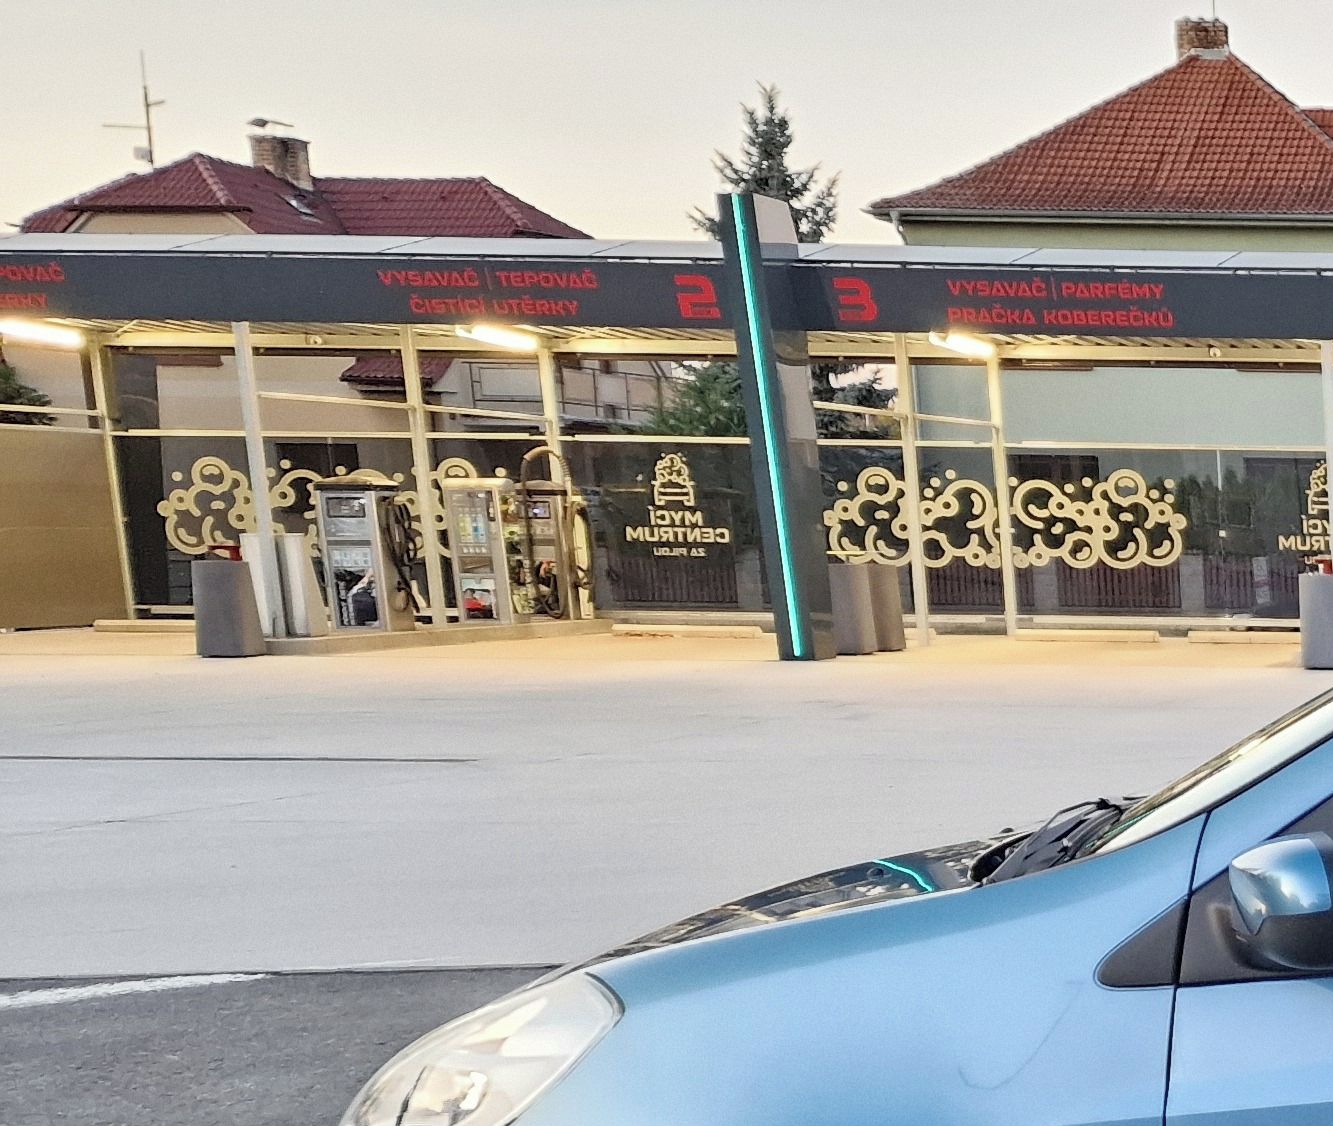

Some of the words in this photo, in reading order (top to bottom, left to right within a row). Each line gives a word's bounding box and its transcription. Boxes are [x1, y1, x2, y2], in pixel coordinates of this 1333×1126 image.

[377, 267, 480, 288] VYSAVAČ
[496, 268, 598, 289] TEPOVAČ
[947, 277, 1048, 298] VYSAVAČ
[1061, 280, 1164, 299] PARFÉMY
[674, 274, 721, 320] 2
[832, 277, 879, 323] 3
[947, 304, 1037, 325] PRAČKA
[1042, 306, 1175, 328] KOBEREČKŮ
